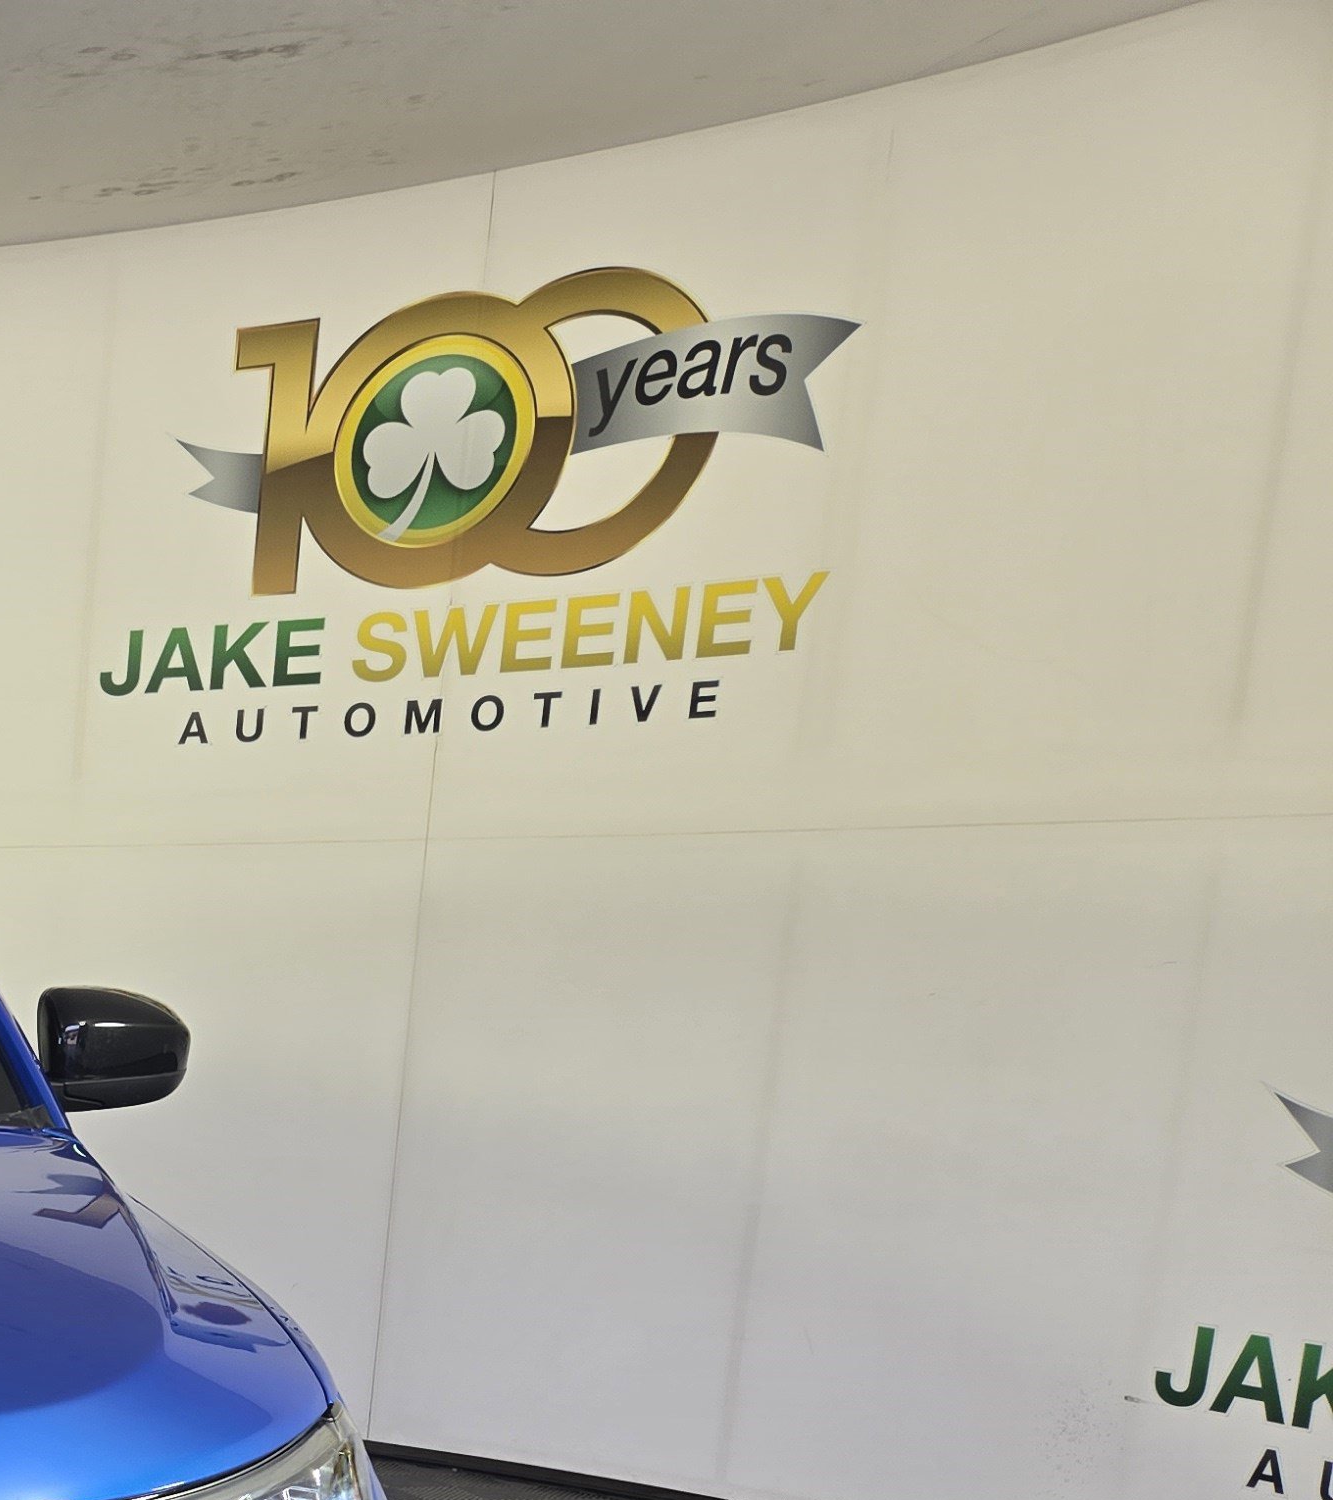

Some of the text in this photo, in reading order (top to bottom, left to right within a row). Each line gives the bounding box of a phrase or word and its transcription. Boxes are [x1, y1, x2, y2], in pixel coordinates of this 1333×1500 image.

[235, 266, 793, 597] 100 years
[99, 571, 830, 697] JAKE SWEENEY
[178, 679, 721, 746] AUTOMOTIVE
